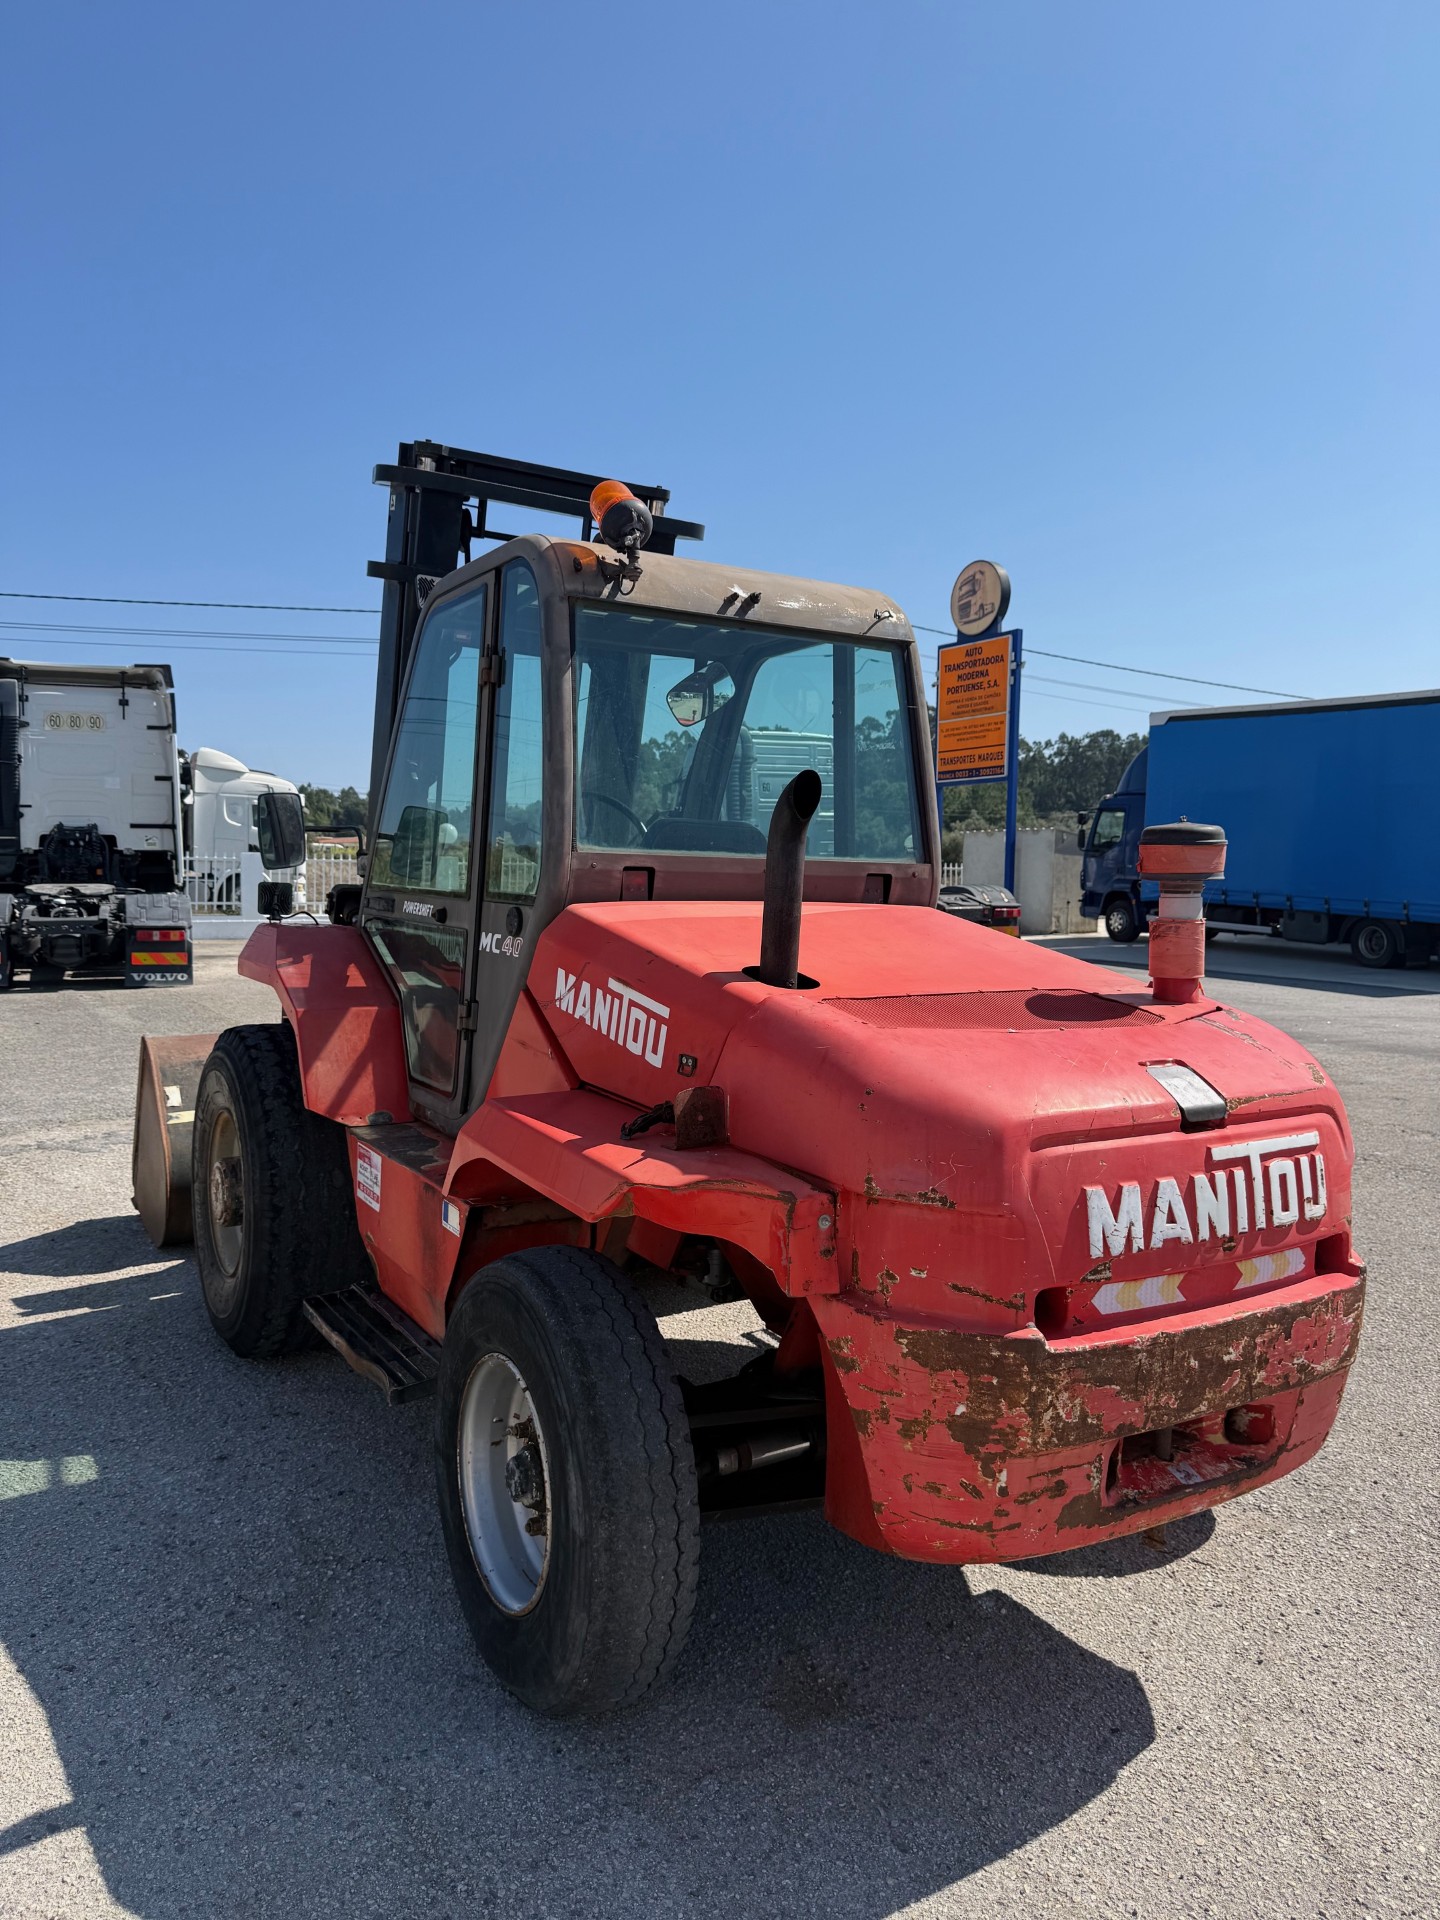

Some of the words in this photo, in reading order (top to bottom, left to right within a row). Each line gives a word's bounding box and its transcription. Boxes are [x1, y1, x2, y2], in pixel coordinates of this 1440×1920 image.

[965, 646, 983, 658] AUTO
[944, 654, 1005, 673] TRANSPORTADORA
[957, 669, 989, 682] MODERNA
[946, 681, 986, 695] PORTUENSE,
[986, 679, 1000, 689] S.A.
[49, 714, 61, 728] 60
[70, 715, 81, 728] 80
[90, 716, 101, 729] 90
[940, 754, 976, 766] TRANSPORTES
[977, 751, 1004, 762] MARQUES
[402, 900, 434, 917] POWERSHIFT
[479, 931, 501, 954] MC
[501, 935, 524, 957] 40
[130, 972, 189, 981] VOLVO
[555, 967, 671, 1069] MANITOU
[1086, 1130, 1328, 1259] MANITOU
